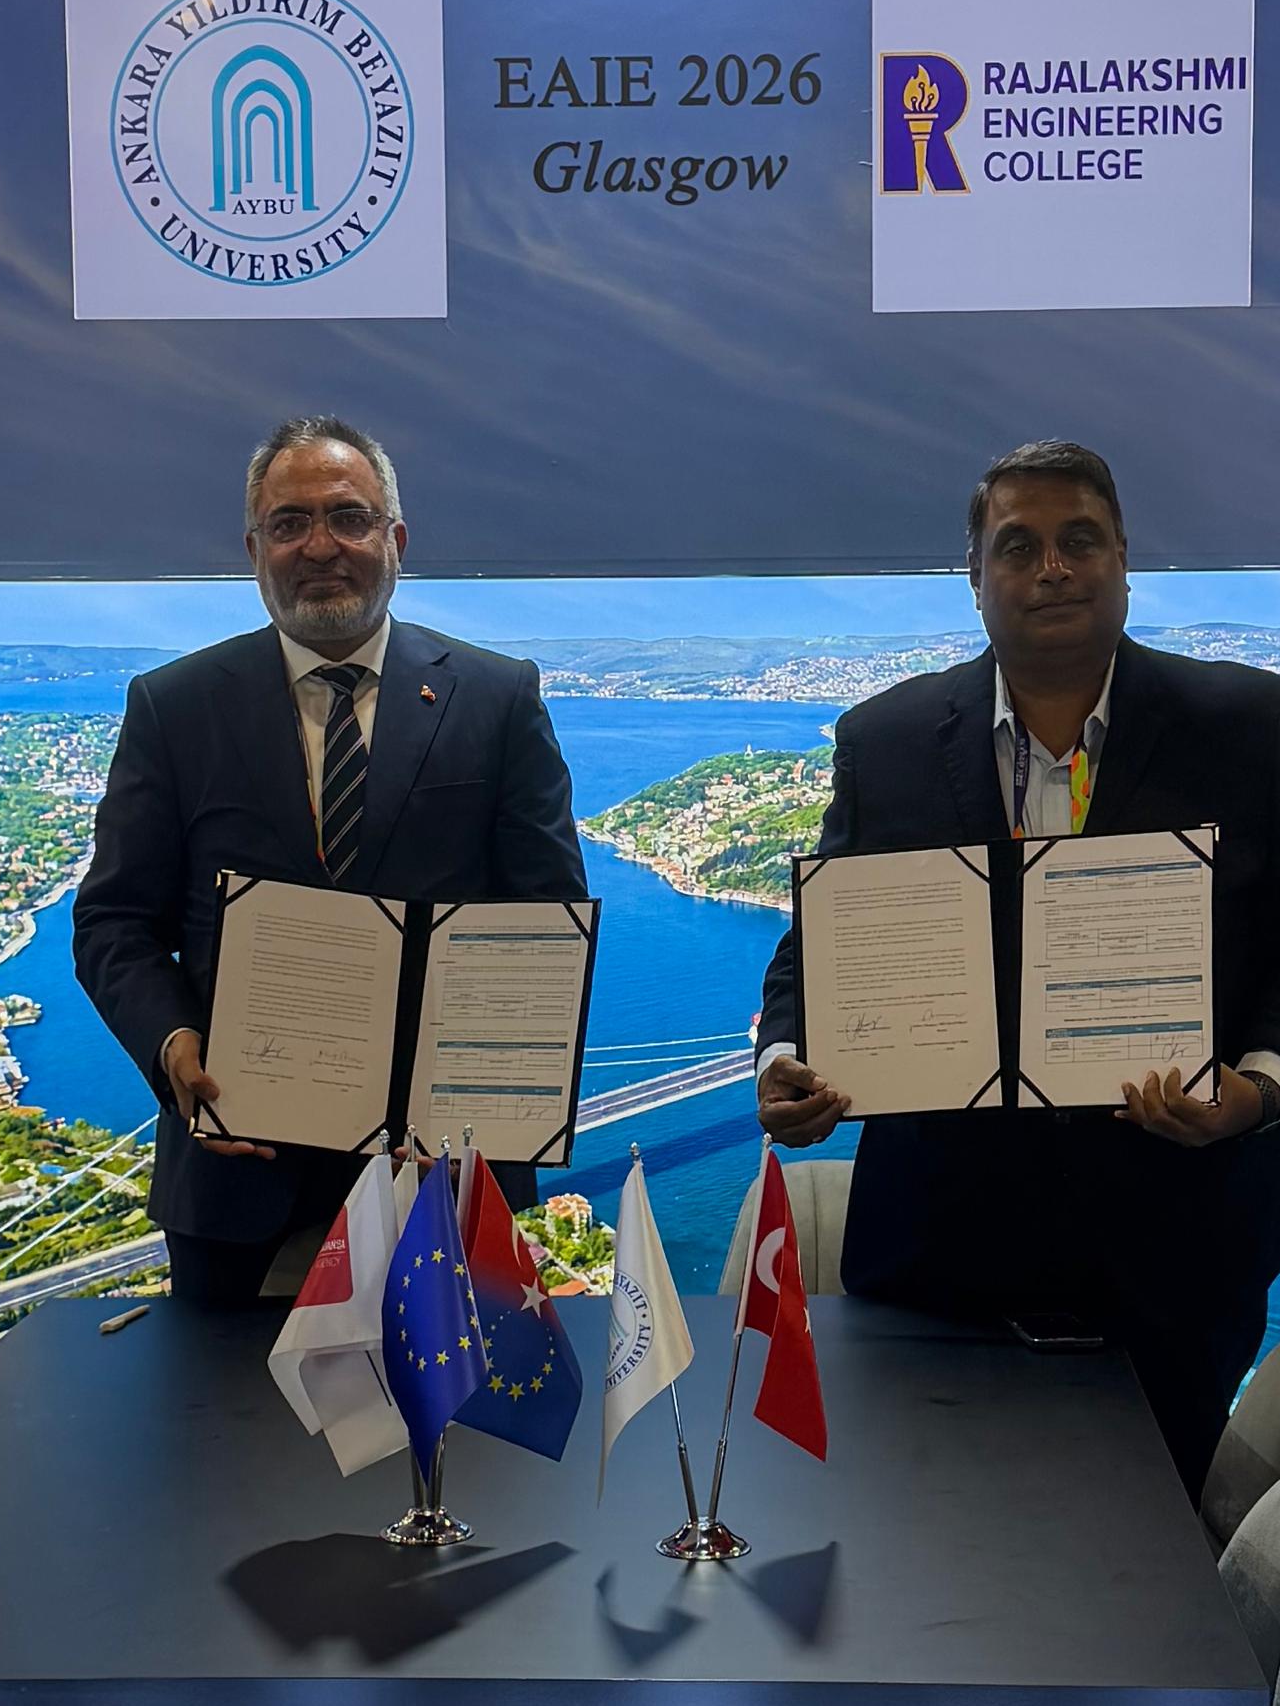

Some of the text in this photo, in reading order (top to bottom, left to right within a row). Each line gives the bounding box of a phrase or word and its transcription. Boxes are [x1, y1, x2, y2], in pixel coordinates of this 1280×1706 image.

[494, 52, 822, 109] EAIE 2026
[984, 56, 1247, 95] RAJALAKSHMI
[120, 43, 173, 185] ANKARA
[343, 28, 404, 189] BEYAZIT
[983, 103, 1223, 139] ENGINEERING
[532, 140, 789, 206] Glasgow
[983, 149, 1143, 182] COLLEGE
[231, 198, 295, 215] AYBU
[159, 211, 372, 282] UNIVERSITY
